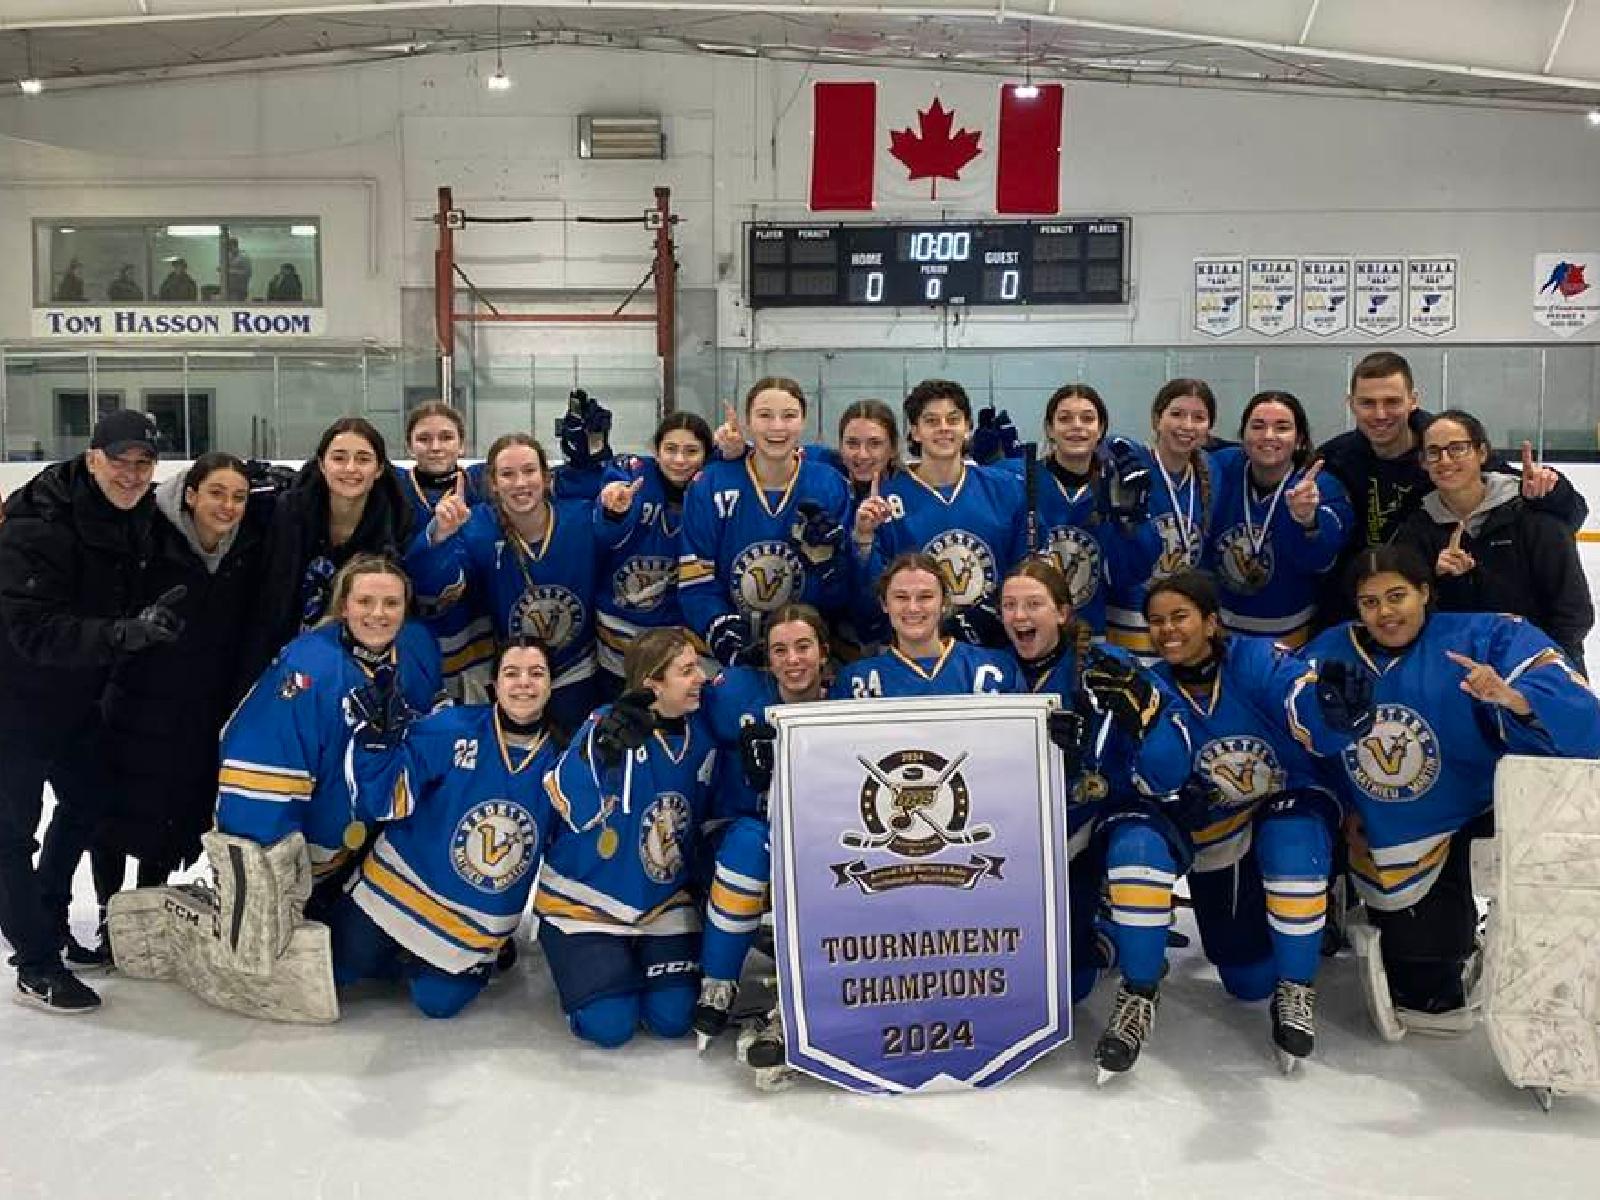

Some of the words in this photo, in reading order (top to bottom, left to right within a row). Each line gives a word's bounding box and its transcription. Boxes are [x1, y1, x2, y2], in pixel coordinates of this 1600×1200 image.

[851, 253, 881, 264] HOME
[911, 232, 970, 261] 10:00
[985, 251, 1018, 263] GUEST
[867, 272, 883, 301] 0
[926, 279, 940, 299] 0
[1002, 271, 1018, 299] 0
[46, 312, 102, 333] TOM
[114, 311, 219, 333] HASSON
[232, 311, 312, 333] ROOM
[713, 488, 740, 518] 17
[851, 669, 882, 699] 24
[973, 665, 1004, 695] C
[454, 739, 479, 770] 22
[165, 898, 199, 927] CCM
[821, 927, 1021, 965] TOURNAMENT
[842, 968, 1007, 1009] CHAMPIONS
[883, 1020, 975, 1057] 2024
